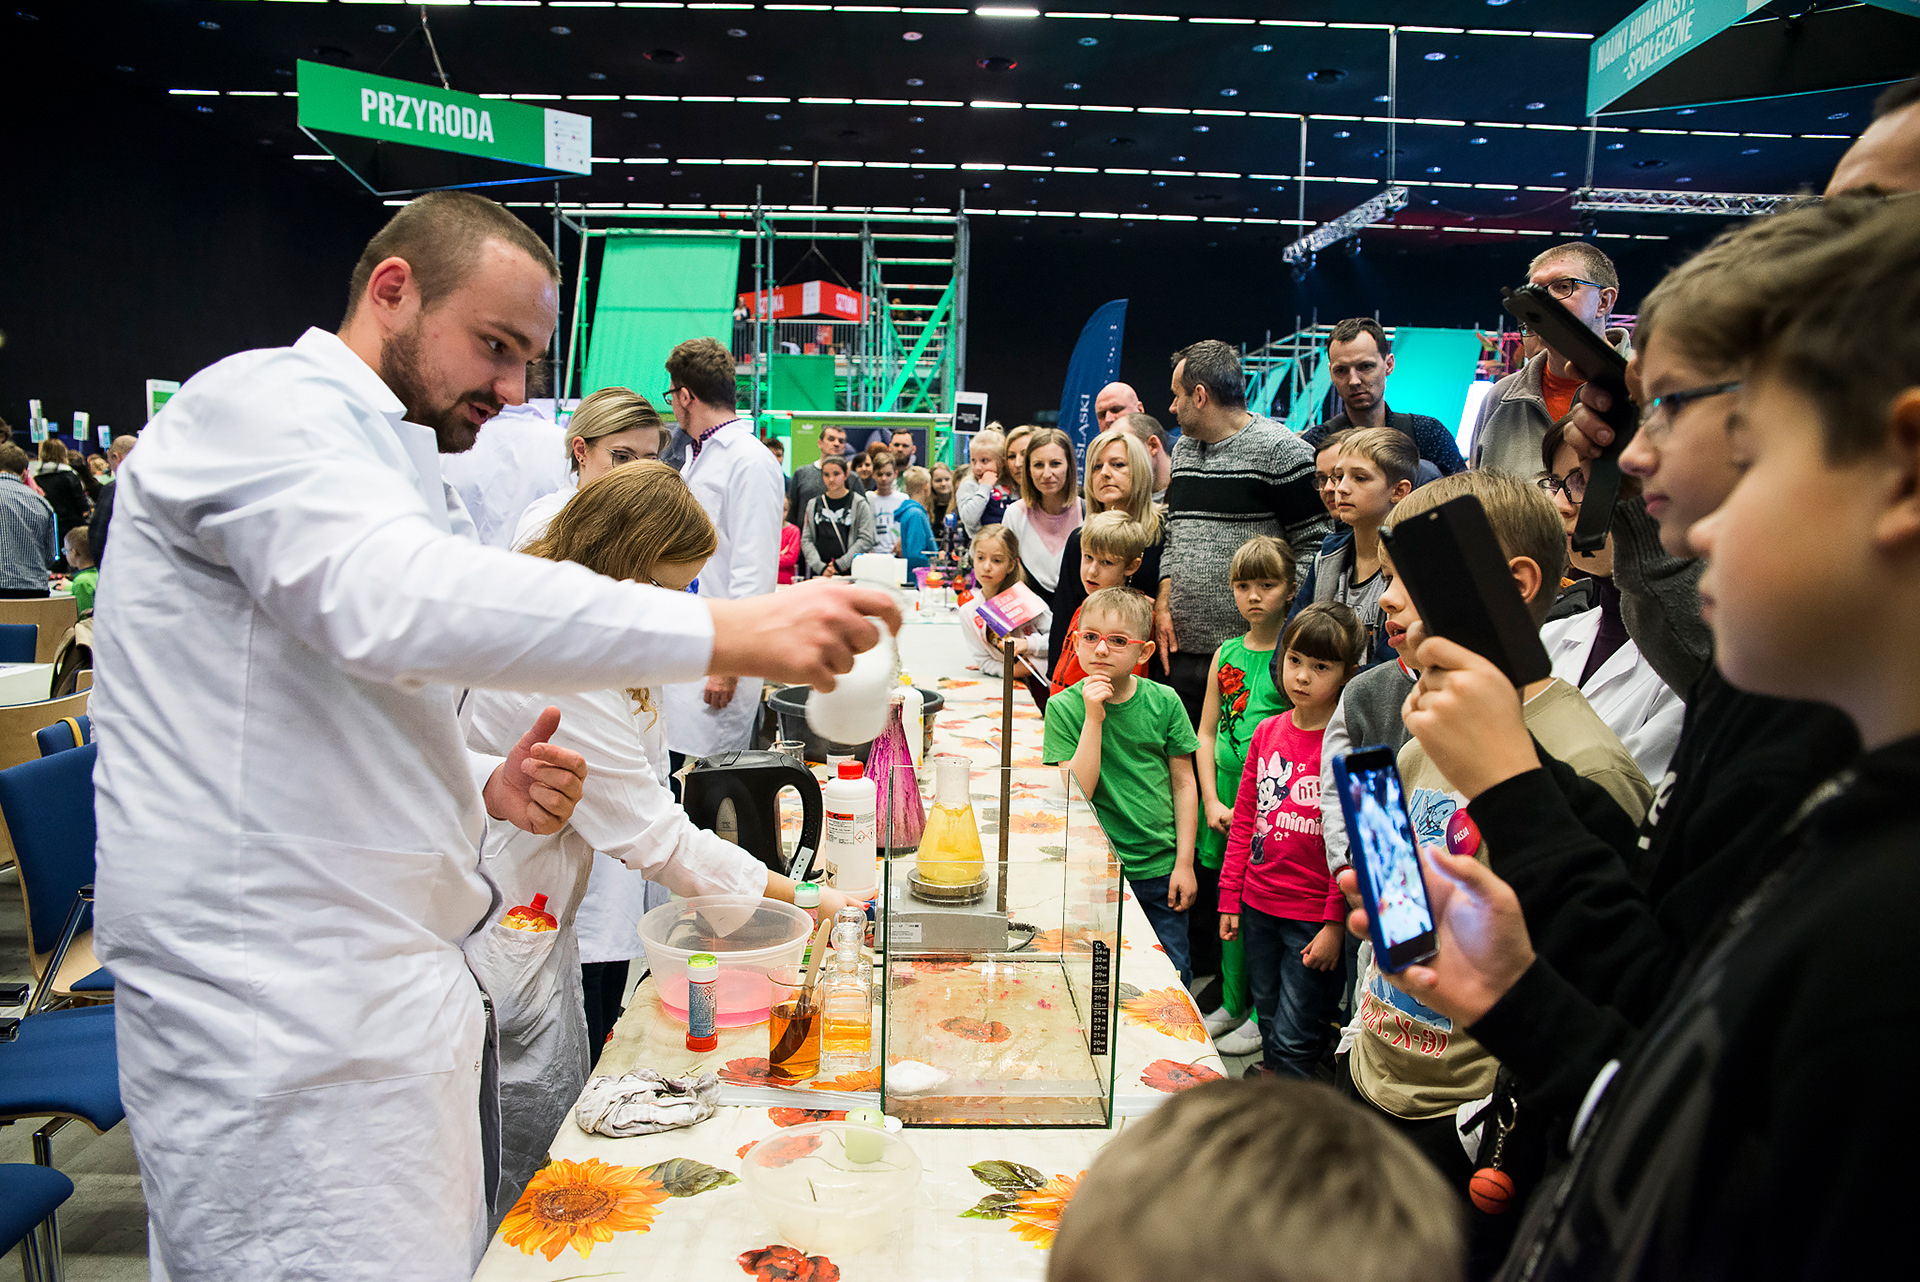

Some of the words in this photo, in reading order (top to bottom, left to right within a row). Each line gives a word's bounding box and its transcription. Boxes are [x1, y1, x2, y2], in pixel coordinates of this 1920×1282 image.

[1597, 25, 1628, 74] NAUKI
[1628, 0, 1694, 50] HUMANIS
[1623, 8, 1696, 80] -SPOŁECZNE
[361, 88, 494, 143] PRZYRODA
[1298, 781, 1321, 800] hi!
